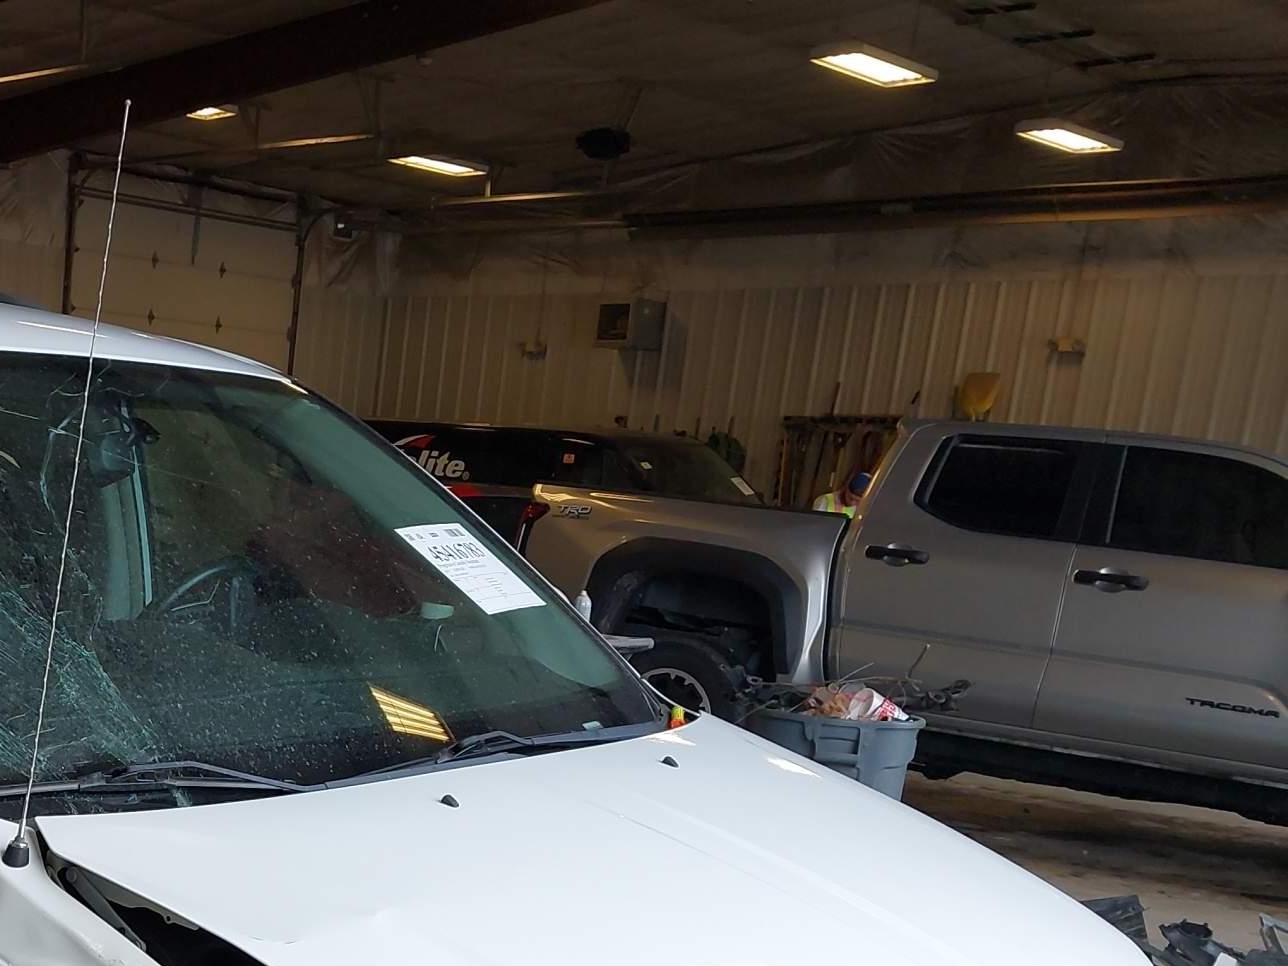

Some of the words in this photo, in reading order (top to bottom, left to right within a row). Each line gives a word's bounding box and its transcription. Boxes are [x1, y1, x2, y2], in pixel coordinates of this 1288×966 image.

[558, 504, 592, 515] TRD
[427, 542, 486, 562] 45416783
[1185, 697, 1280, 718] TACOMA
